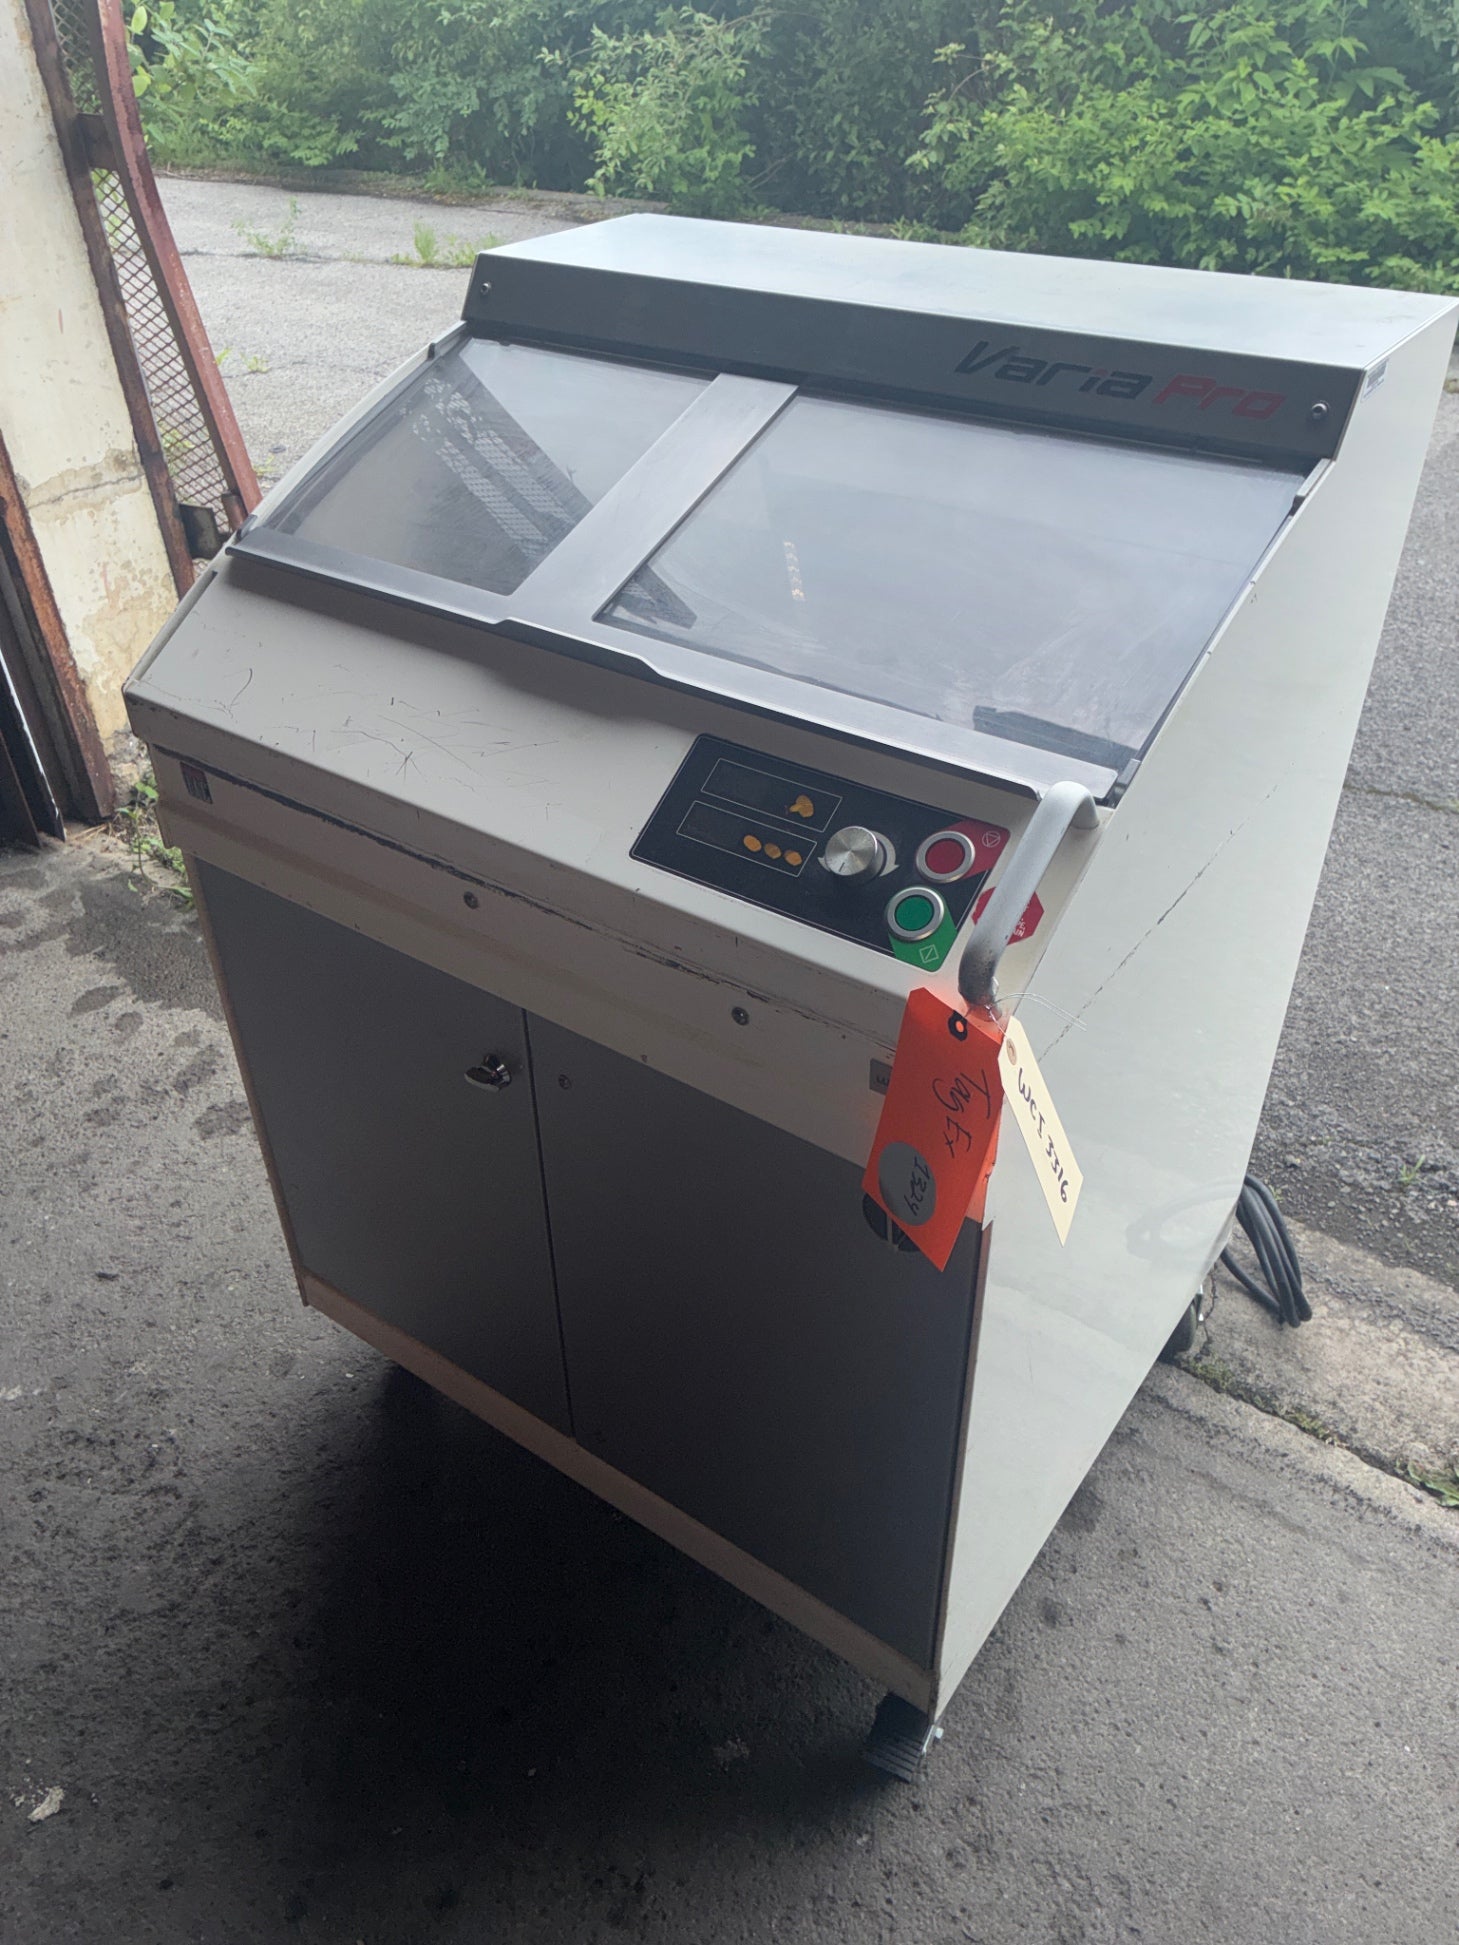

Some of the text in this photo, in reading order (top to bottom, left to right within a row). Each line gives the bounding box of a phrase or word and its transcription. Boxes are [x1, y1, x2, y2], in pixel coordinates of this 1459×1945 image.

[954, 340, 1285, 420] Varia Pro
[1018, 1067, 1069, 1203] WCI 3316
[904, 1156, 930, 1216] 1324
